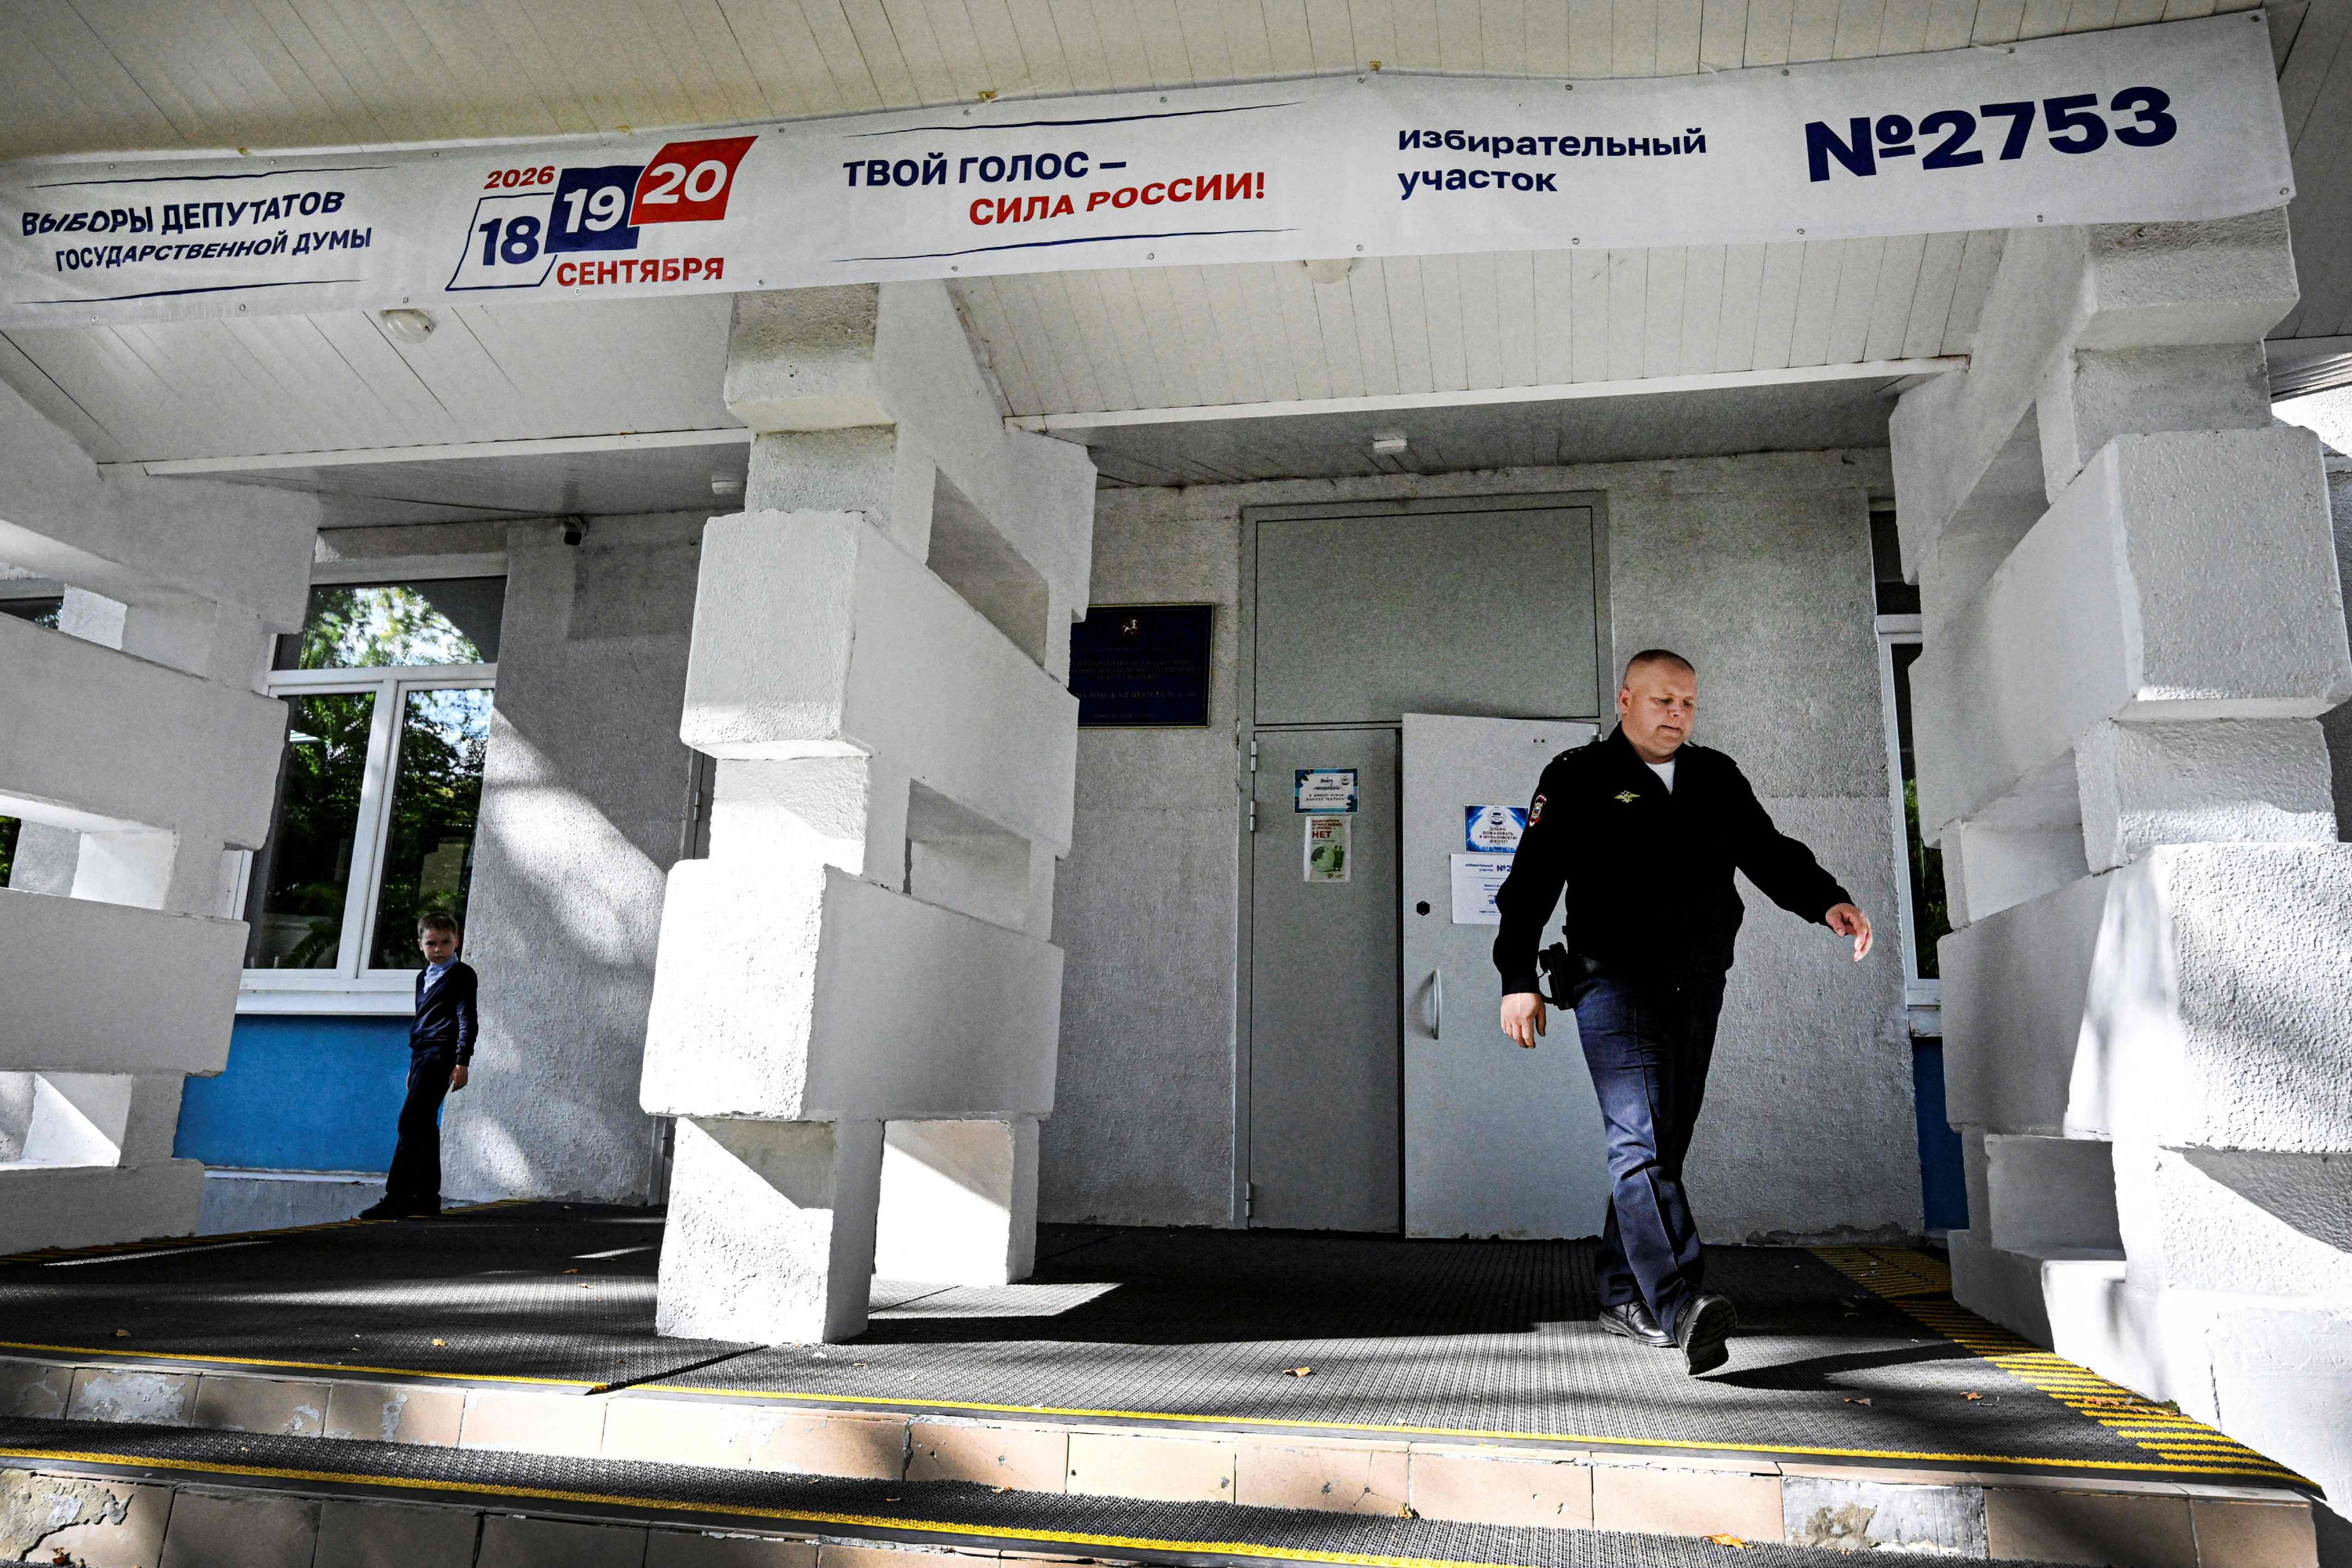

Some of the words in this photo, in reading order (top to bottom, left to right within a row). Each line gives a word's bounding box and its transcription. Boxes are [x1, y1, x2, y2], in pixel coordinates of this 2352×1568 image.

[1399, 127, 1707, 159] избирательный
[1805, 86, 2177, 183] №2753
[484, 165, 556, 189] 2026
[641, 159, 728, 205] 20
[843, 151, 948, 187] ТВОЙ
[959, 151, 1089, 183] ГОЛОС
[1398, 169, 1558, 201] участок
[22, 206, 154, 237] ВЫБОРЫ
[161, 191, 346, 236] ДЕПУТАТОВ
[563, 186, 626, 233] 19
[970, 194, 1074, 226] СИЛА
[1087, 172, 1265, 212] РОССИИ!
[56, 230, 289, 272] ГОСУДАРСТВЕННОЙ
[291, 227, 372, 256] ДУМЫ
[477, 216, 542, 266] 18
[557, 256, 724, 287] СЕНТЯБРЯ
